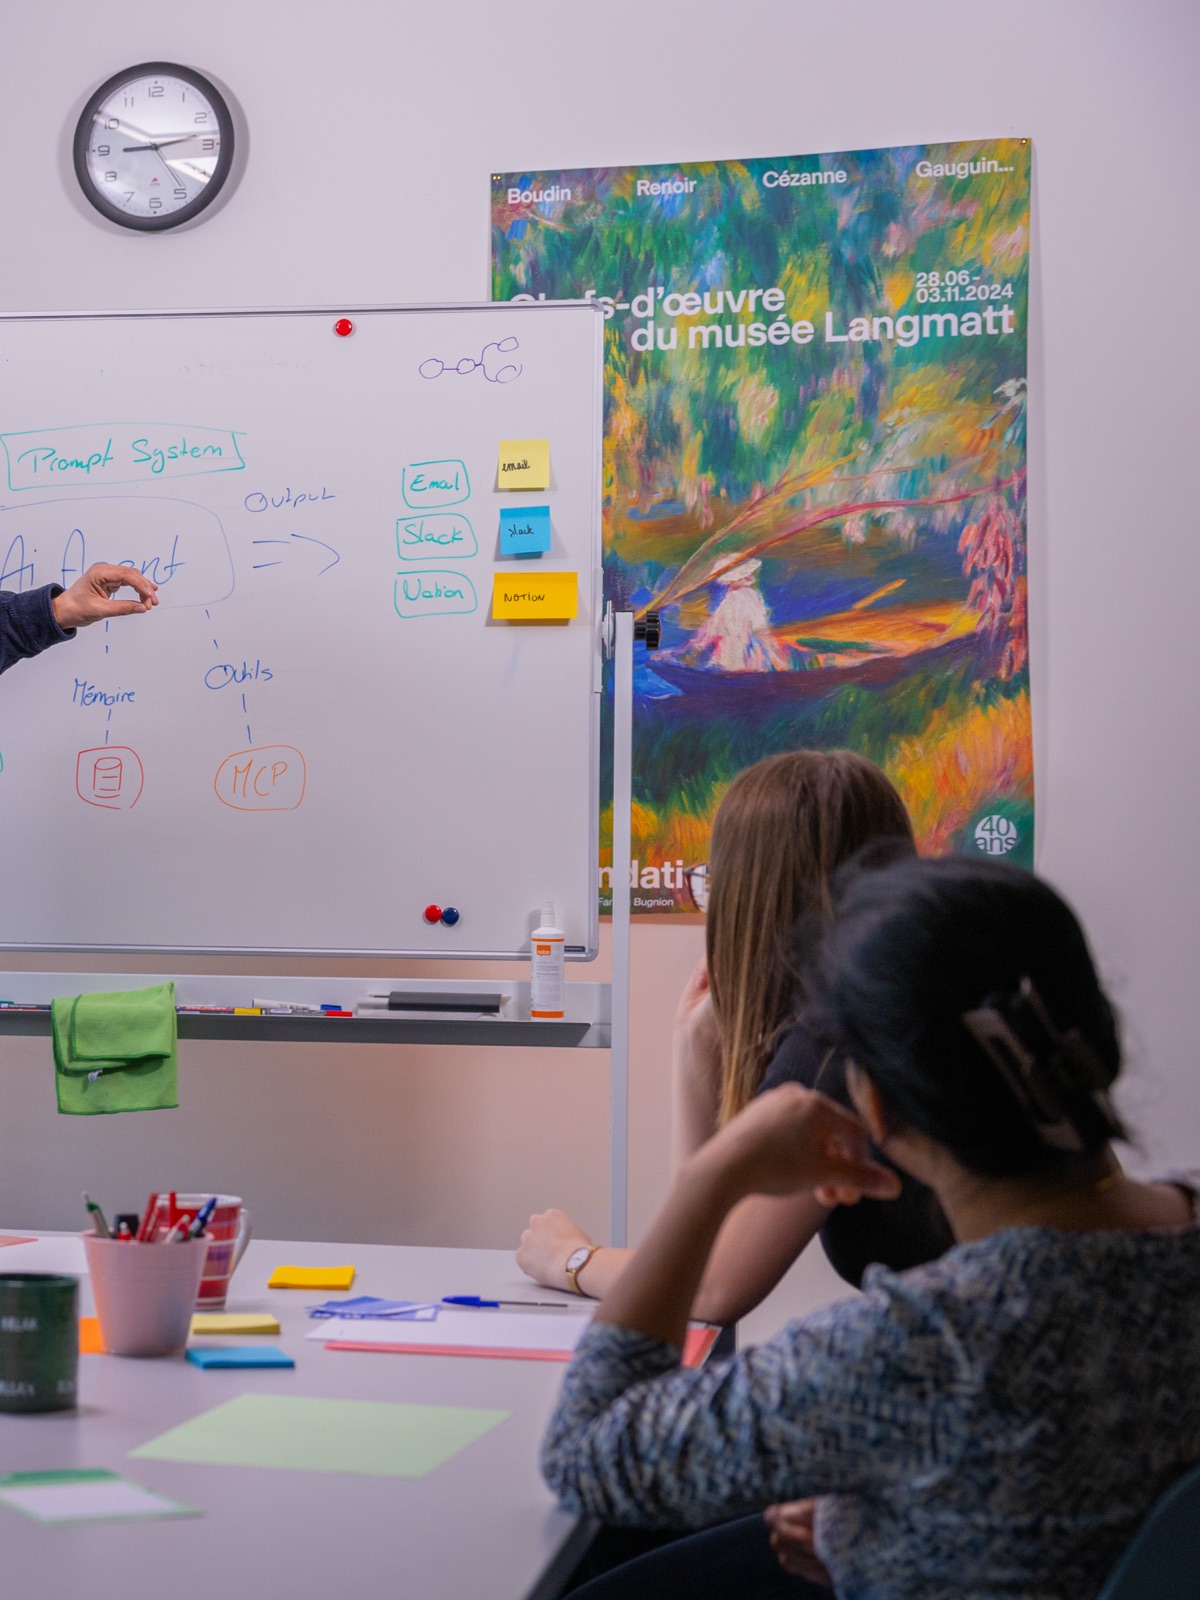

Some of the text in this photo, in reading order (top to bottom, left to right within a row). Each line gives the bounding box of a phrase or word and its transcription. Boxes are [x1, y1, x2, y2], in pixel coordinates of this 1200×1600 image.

[148, 86, 165, 98] 12
[124, 97, 134, 108] 11
[104, 118, 120, 131] 10
[194, 112, 208, 124] 2
[97, 145, 111, 157] 9
[202, 138, 215, 151] 3
[104, 171, 118, 183] 8
[915, 157, 1015, 180] Gauguin...
[636, 177, 698, 196] Renoir
[762, 169, 847, 189] Cézanne
[123, 191, 136, 204] 7
[149, 198, 163, 209] 6
[174, 188, 187, 200] 5
[506, 185, 572, 205] Boudin
[915, 283, 1015, 304] 03.11.2024
[630, 303, 1015, 352] du musée Langmatt
[17, 437, 223, 475] Prompt System
[409, 471, 460, 492] Email
[244, 486, 337, 513] Output
[402, 520, 465, 545] Slack
[203, 659, 274, 690] Outils
[72, 677, 137, 707] Mémoire
[233, 758, 288, 798] MCP
[981, 815, 1011, 837] 40
[975, 836, 1018, 853] ans
[633, 897, 675, 908] Bugnion
